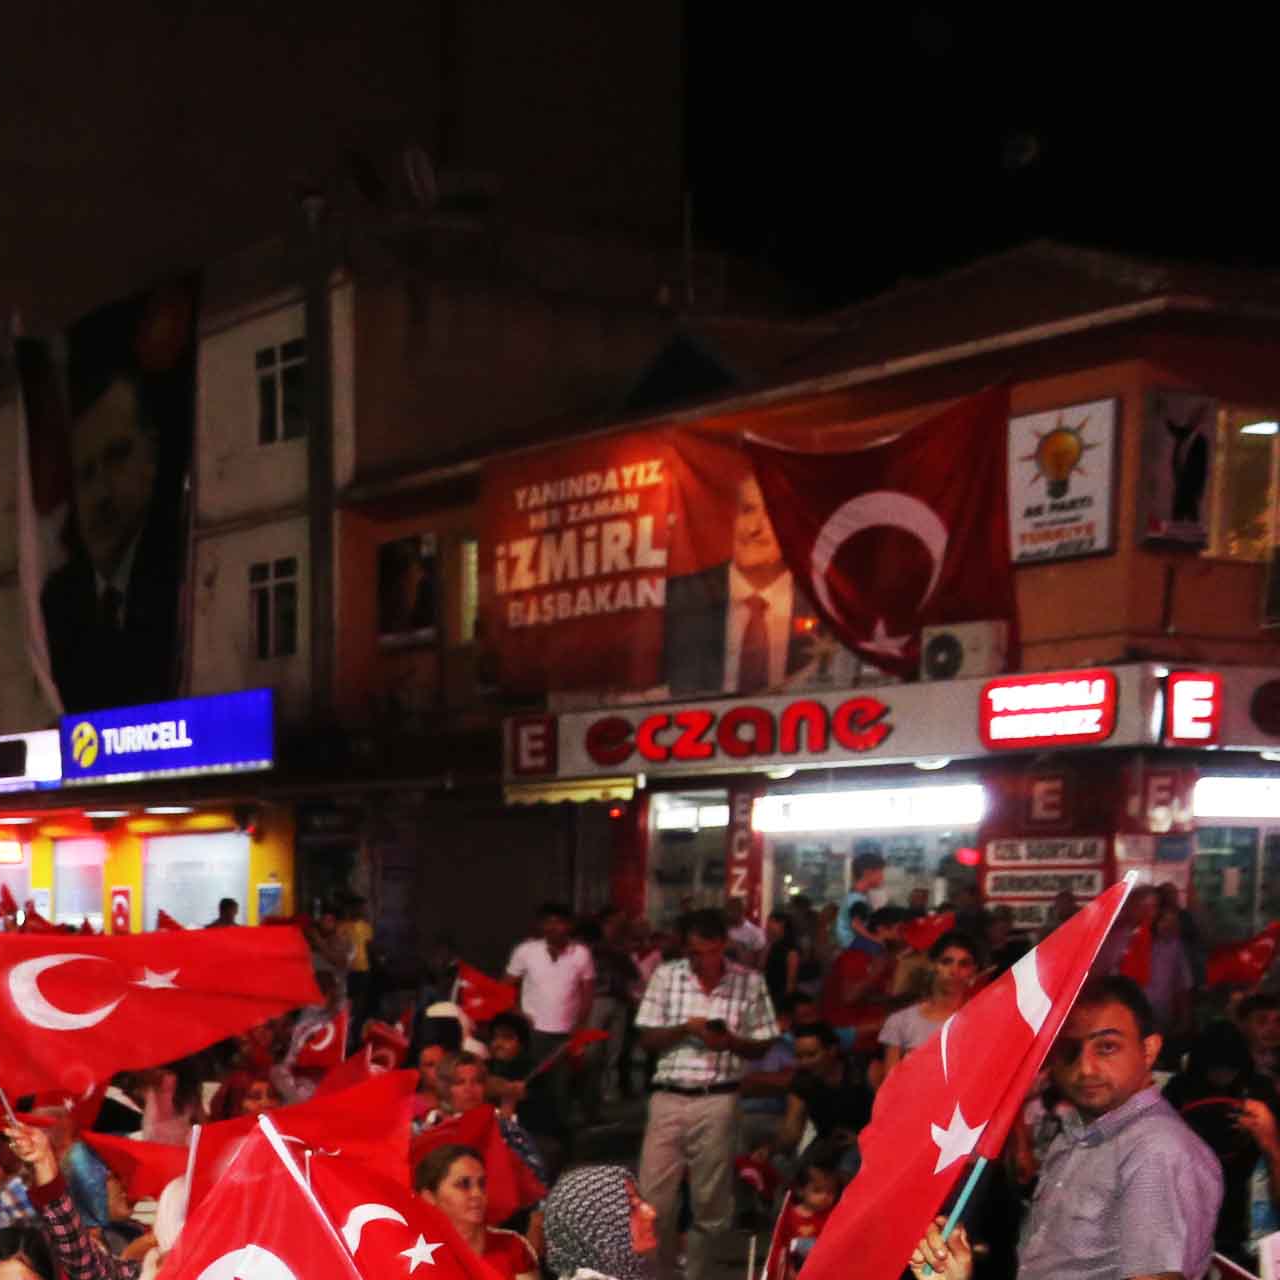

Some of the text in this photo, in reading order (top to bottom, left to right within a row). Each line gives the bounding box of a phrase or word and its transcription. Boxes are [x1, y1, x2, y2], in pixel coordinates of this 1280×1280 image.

[585, 696, 892, 766] eczane
[1173, 680, 1215, 739] E
[101, 719, 193, 755] TURKCELL
[519, 723, 546, 767] E
